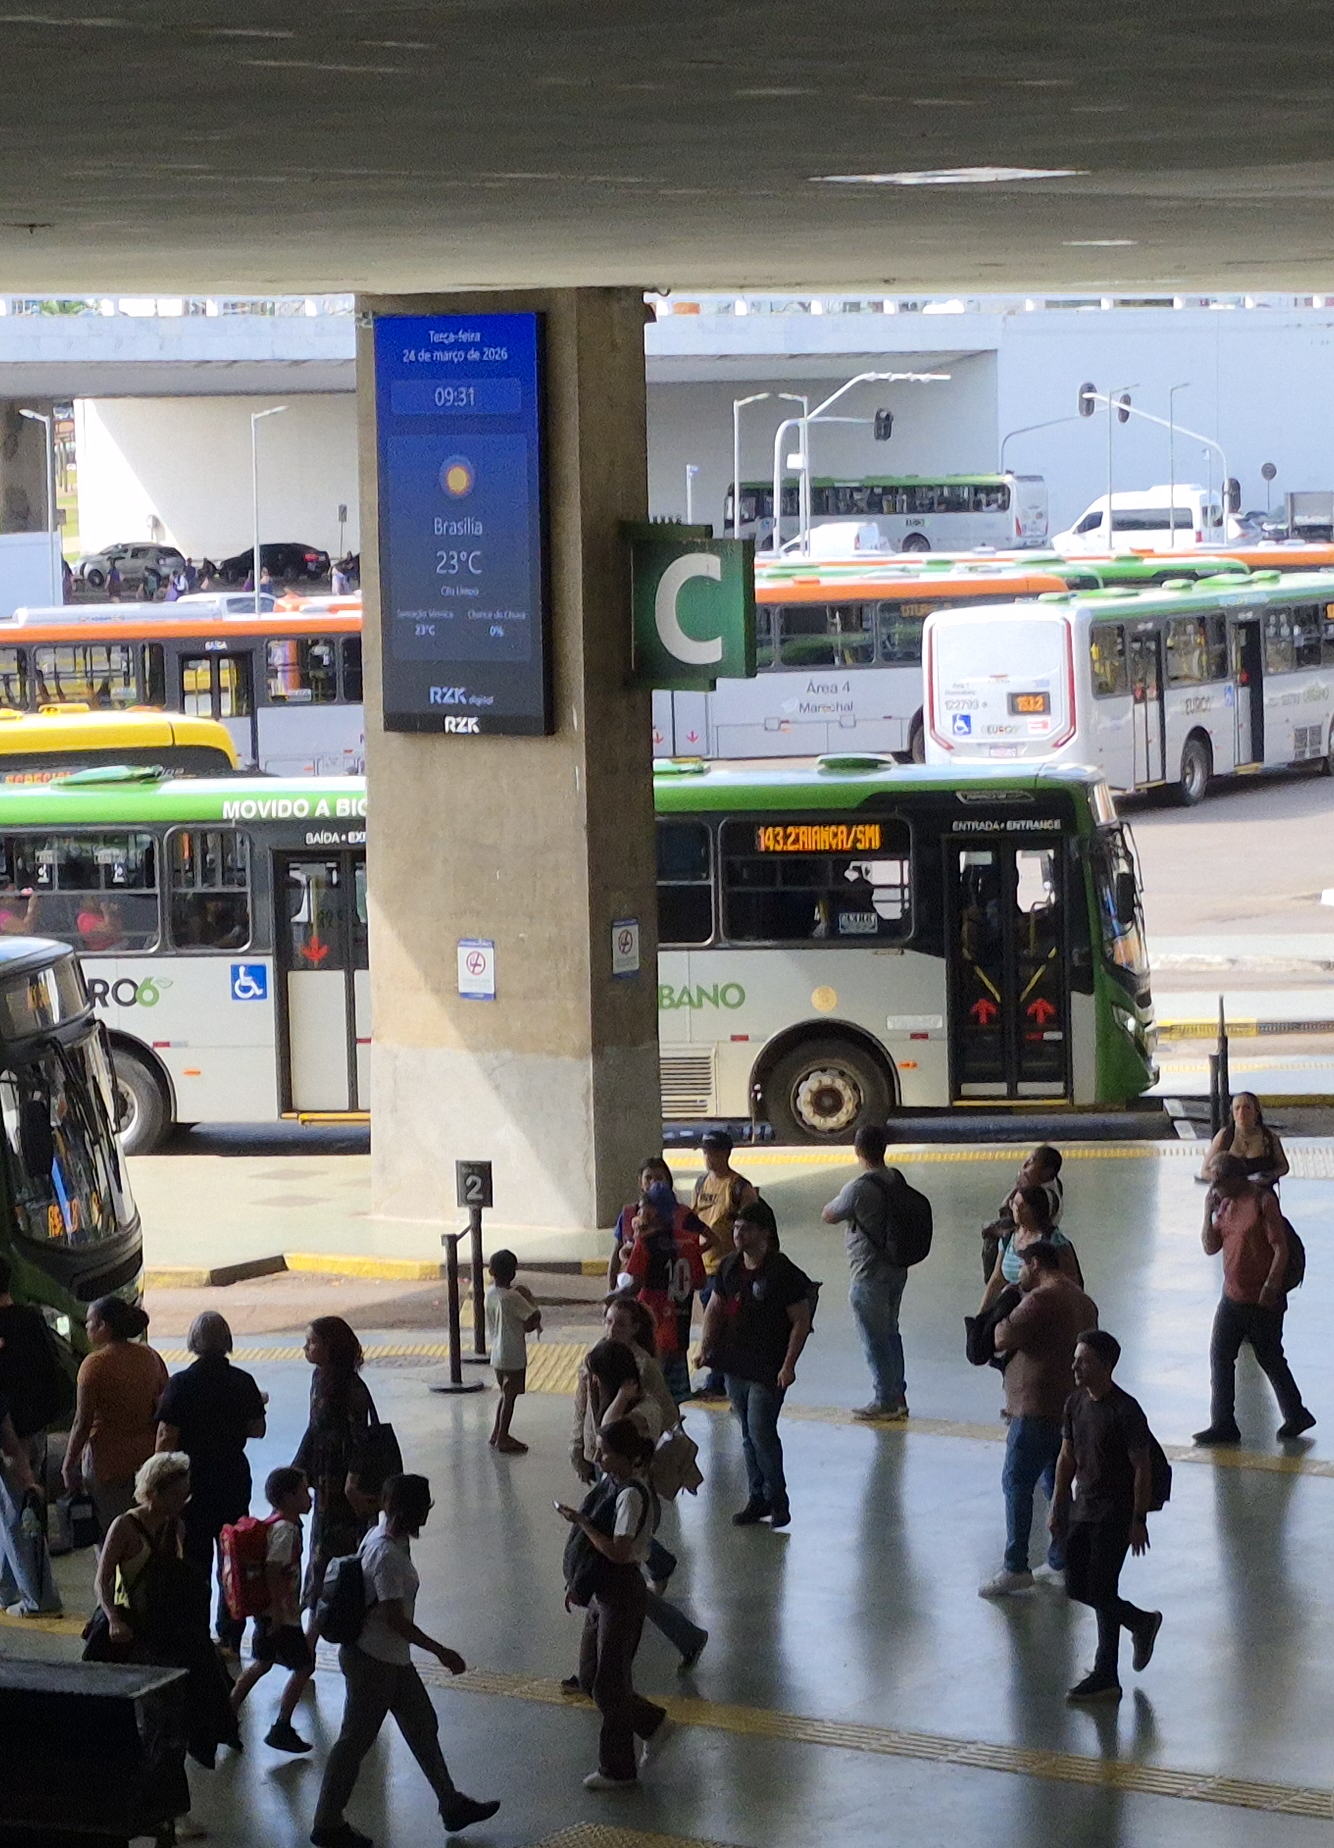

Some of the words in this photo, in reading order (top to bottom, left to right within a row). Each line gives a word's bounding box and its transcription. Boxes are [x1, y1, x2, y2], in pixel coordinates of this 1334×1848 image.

[429, 329, 481, 345] Terça-feira
[403, 349, 416, 362] 24
[418, 349, 431, 362] de
[433, 350, 464, 363] março
[467, 348, 480, 361] de
[482, 347, 508, 360] 2026
[435, 387, 475, 407] 09:31
[434, 517, 483, 536] Brasília
[655, 552, 722, 664] C
[429, 686, 466, 704] RZK
[806, 679, 838, 694] Área
[842, 681, 851, 693] 4
[799, 701, 854, 714] Marechal
[444, 716, 480, 734] RZK
[223, 798, 310, 819] MOVIDO
[315, 799, 330, 817] A
[952, 820, 1001, 832] ENTRADA
[1006, 819, 1061, 831] ENTRANCE
[306, 830, 340, 846] SAÍDA
[658, 981, 746, 1010] BANO
[465, 1175, 484, 1201] 2
[664, 1258, 691, 1303] 10
